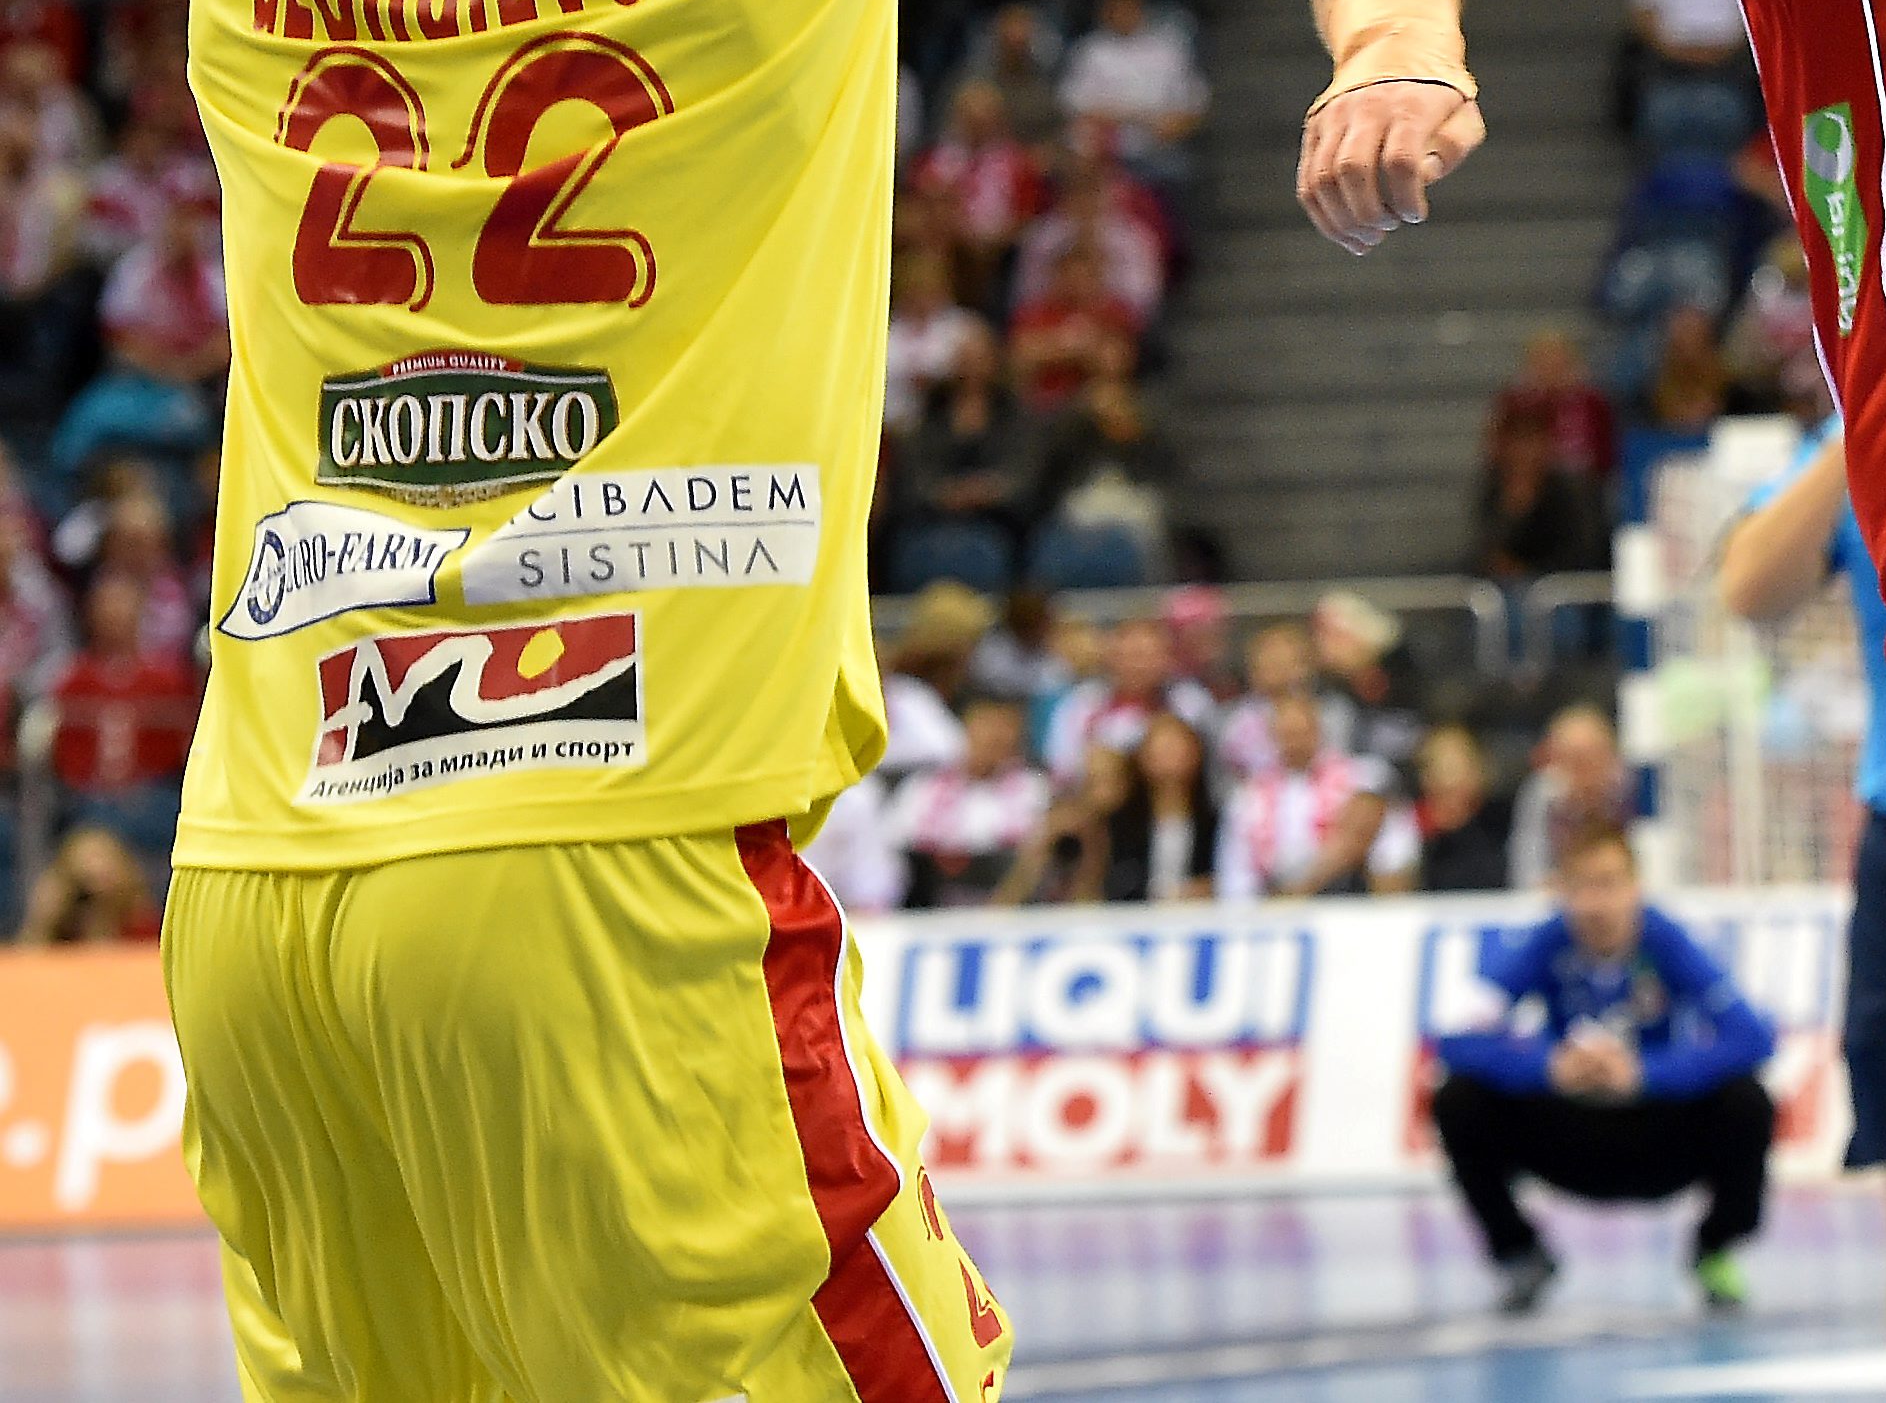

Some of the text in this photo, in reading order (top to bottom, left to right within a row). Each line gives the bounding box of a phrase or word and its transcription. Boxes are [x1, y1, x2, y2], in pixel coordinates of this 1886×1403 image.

[274, 30, 675, 312] 22
[392, 354, 508, 376] PREMIUM QUALITY
[510, 472, 807, 523] CIBADEM
[517, 537, 780, 589] SISTINA
[409, 758, 434, 782] за
[439, 747, 525, 776] млади
[530, 742, 547, 760] и
[554, 739, 636, 764] спорт
[905, 933, 1310, 1048] LIQUI
[908, 1054, 1302, 1161] MOLY
